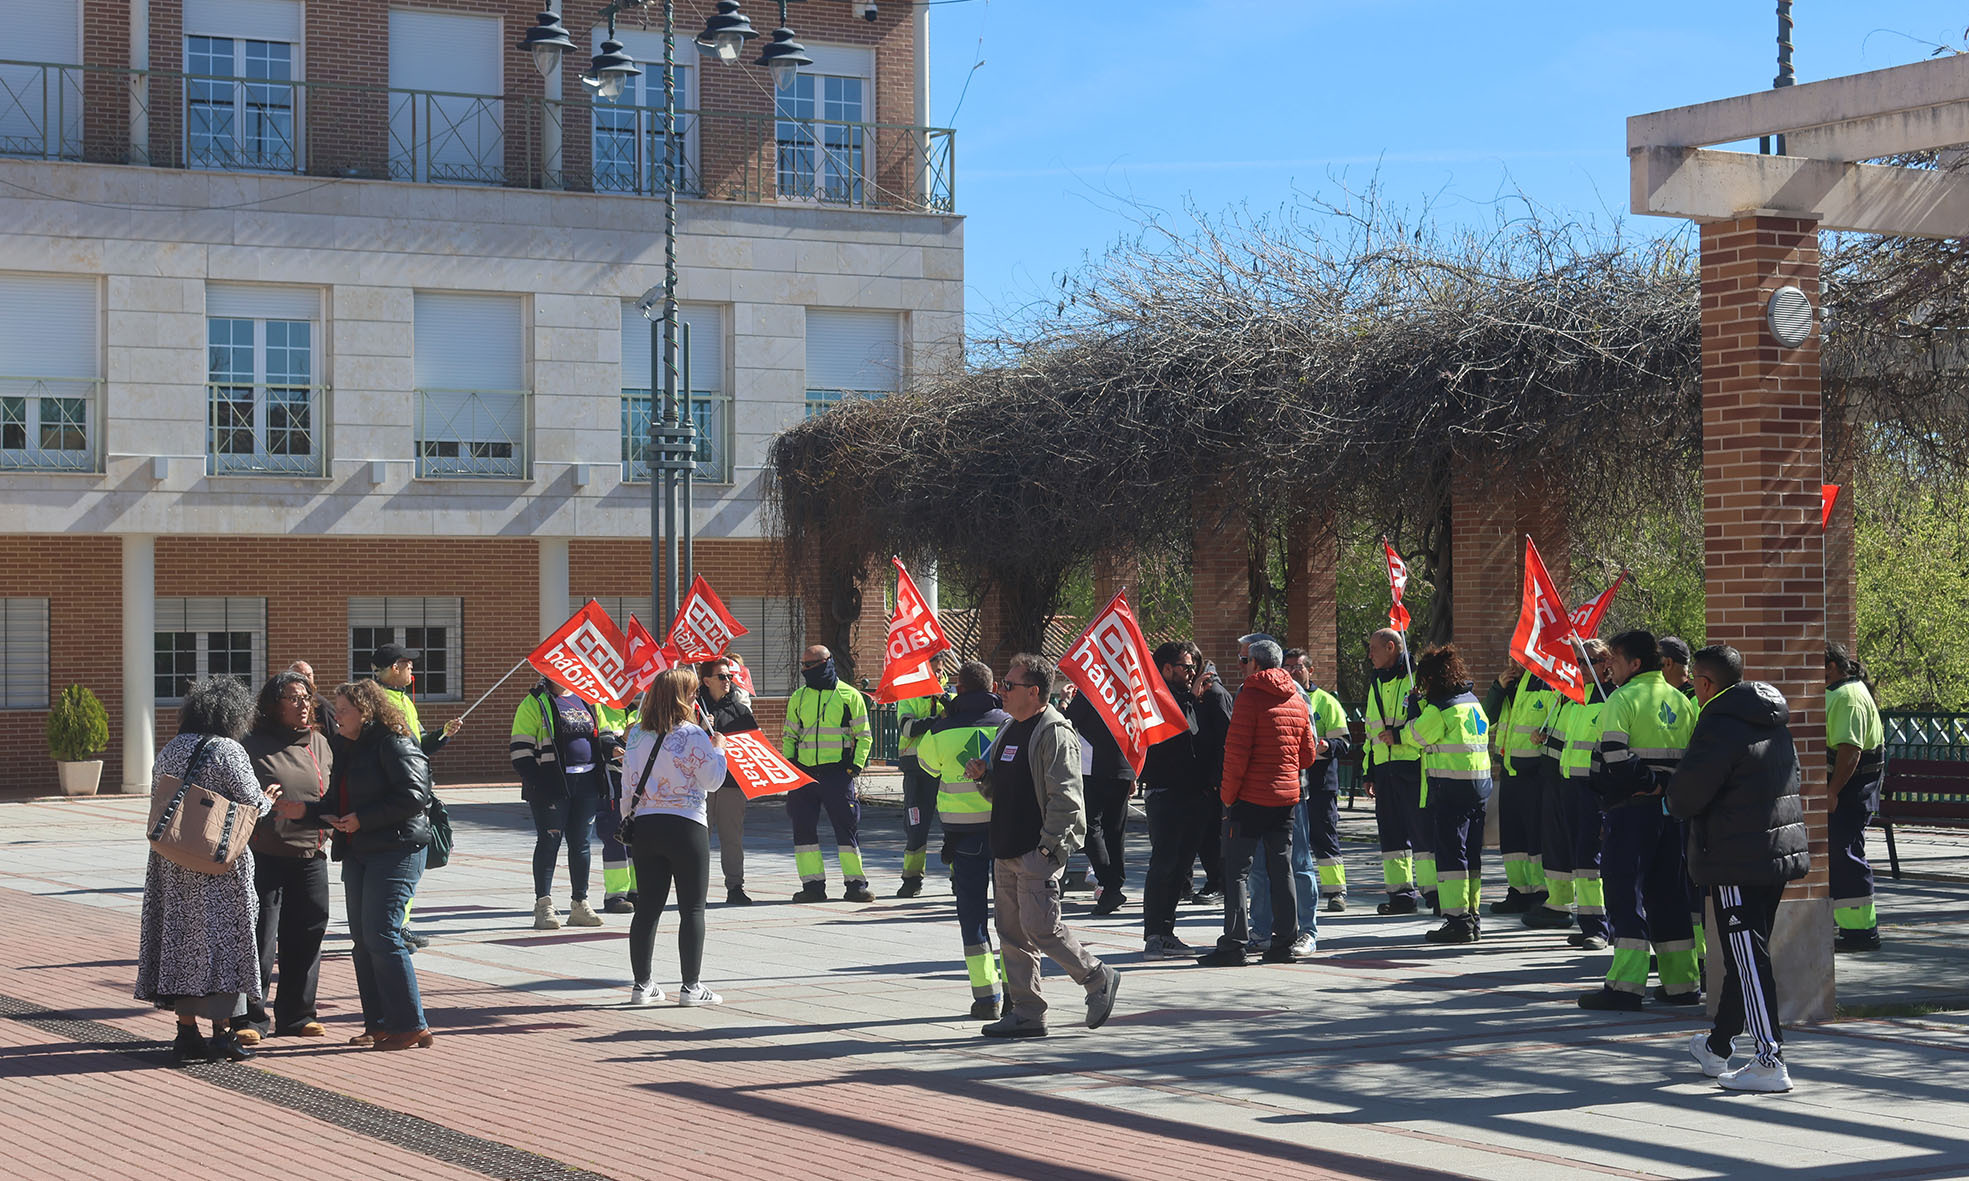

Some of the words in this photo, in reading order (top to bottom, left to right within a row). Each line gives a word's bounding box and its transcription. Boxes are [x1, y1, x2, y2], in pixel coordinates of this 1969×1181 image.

[672, 619, 711, 659] hábit
[574, 629, 630, 693] CCOO
[734, 736, 791, 779] CCOO
